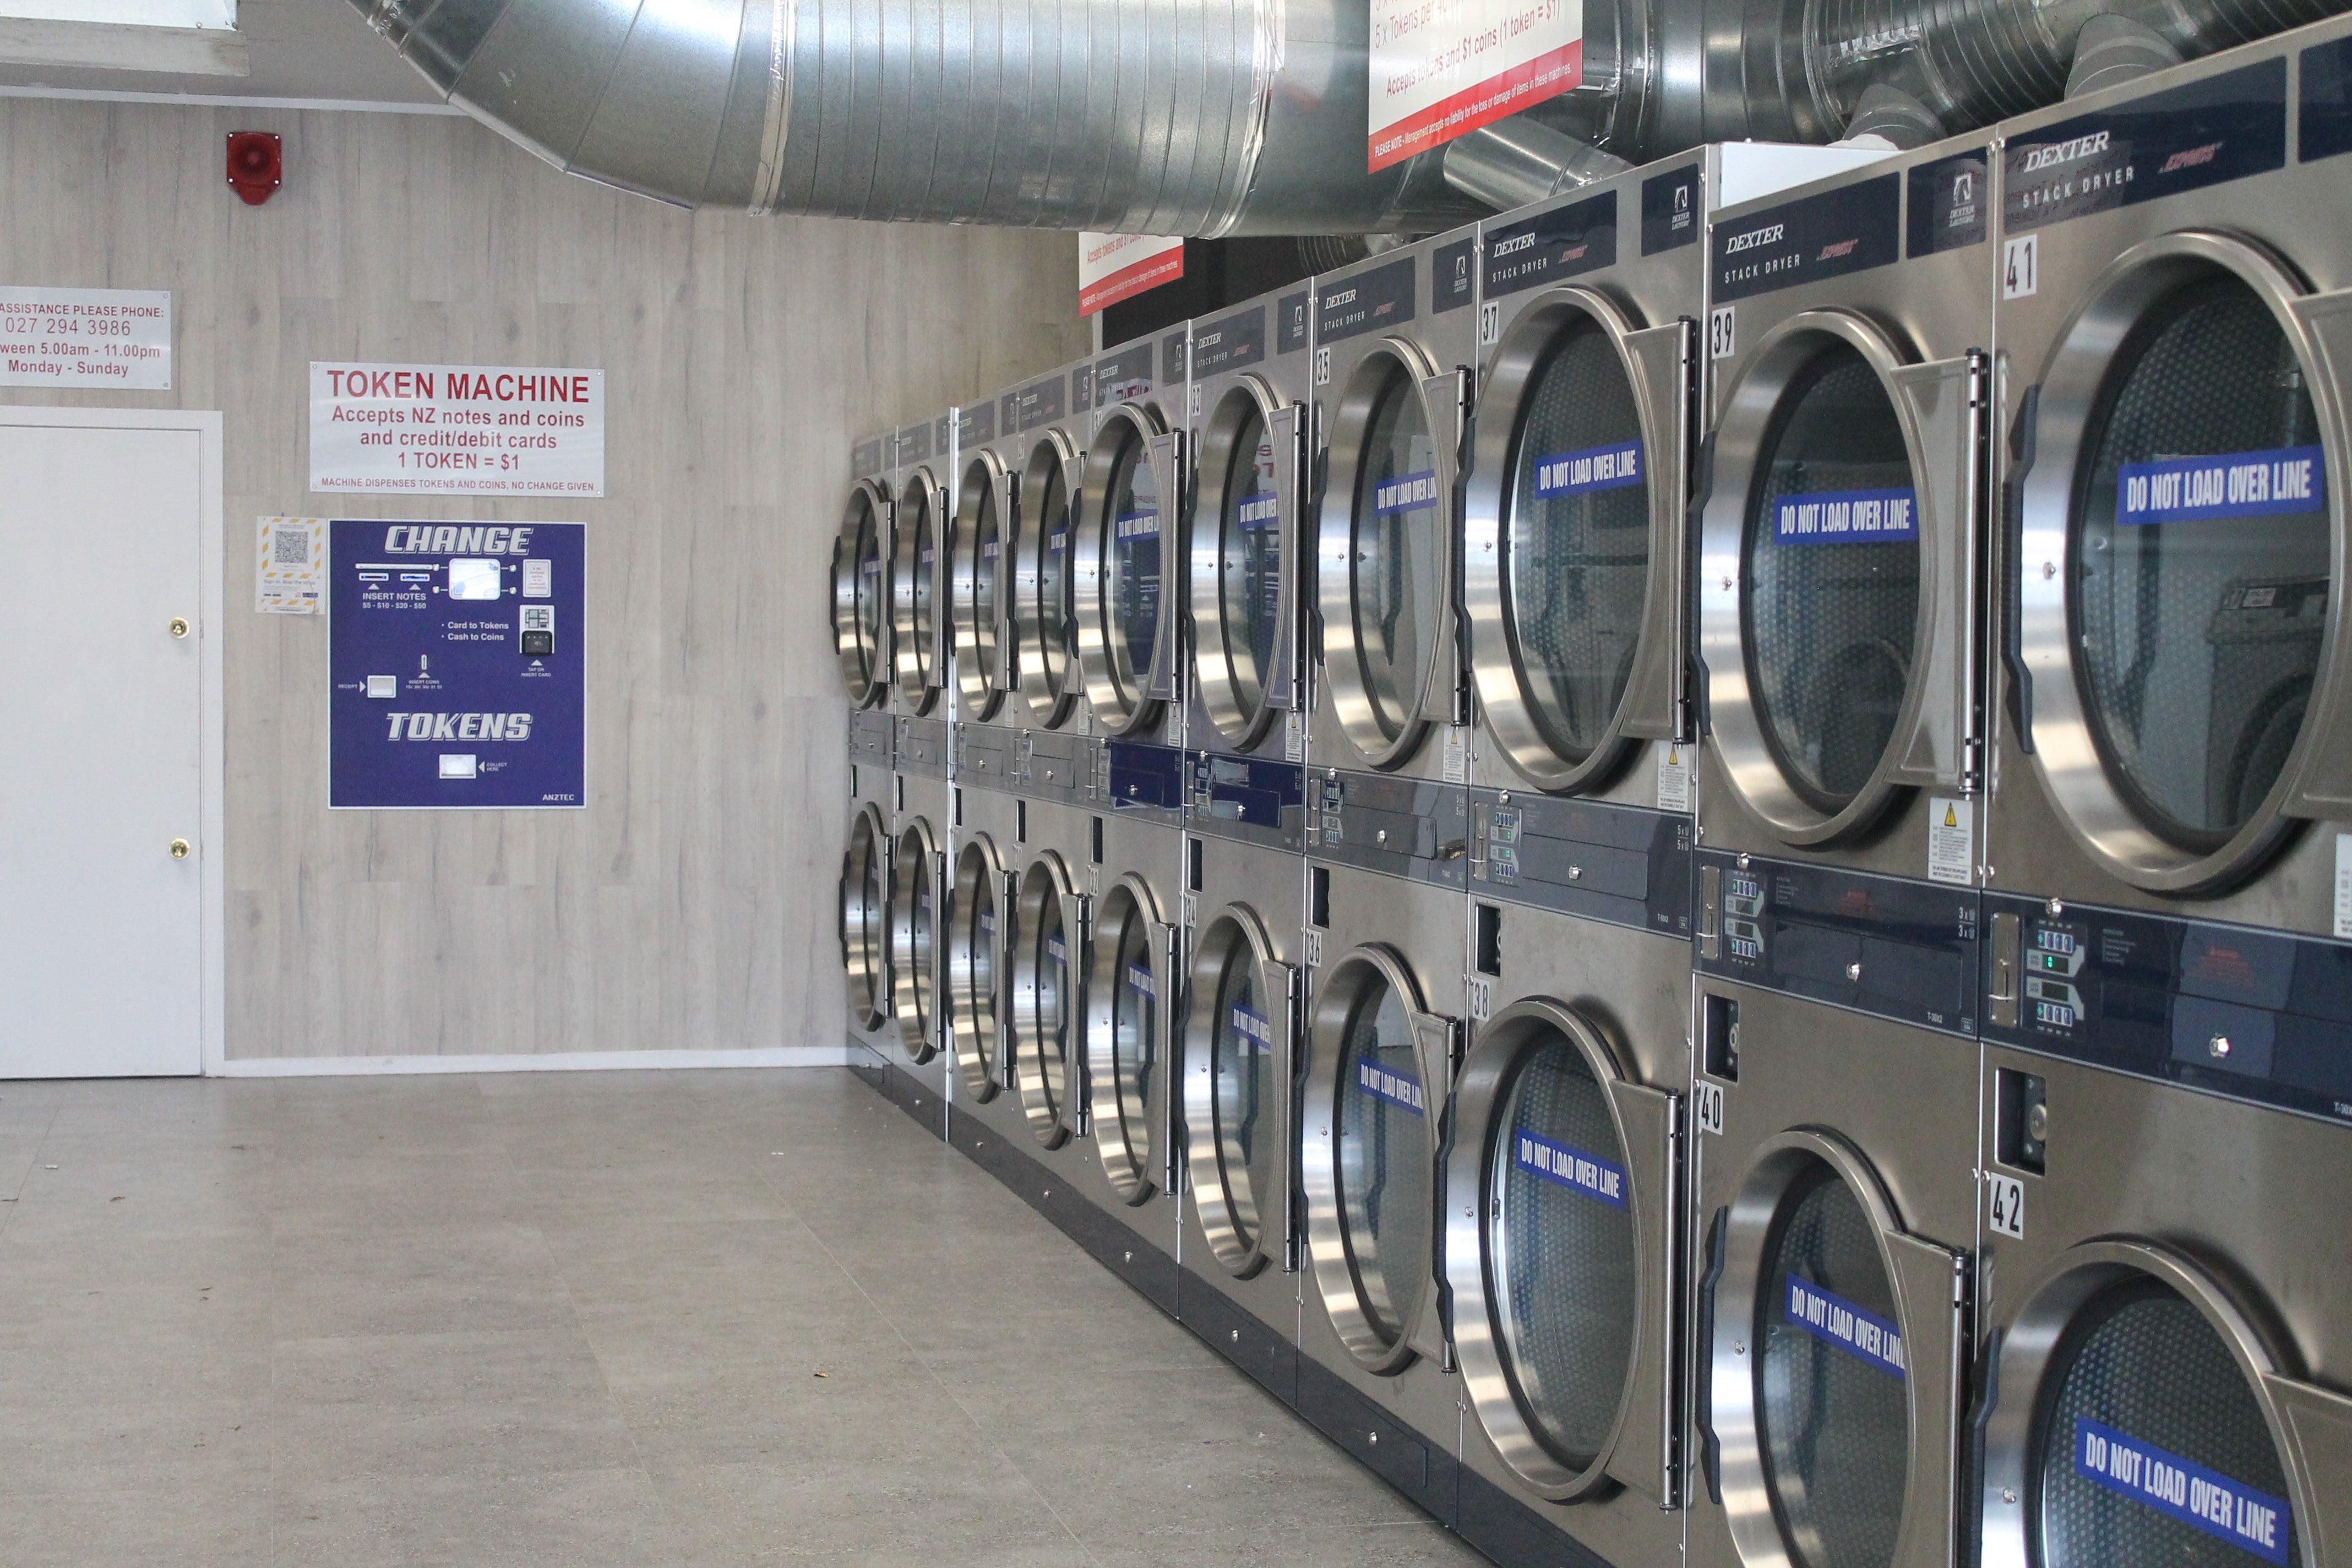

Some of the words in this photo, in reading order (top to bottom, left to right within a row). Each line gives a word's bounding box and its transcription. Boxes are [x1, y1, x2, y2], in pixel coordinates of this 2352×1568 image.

[1376, 24, 1380, 49] 5
[1382, 26, 1387, 45] x
[1390, 9, 1418, 41] Tokens
[1386, 70, 1416, 98] Accepts
[1418, 54, 1444, 87] tokens
[1445, 41, 1460, 70] and
[1463, 35, 1472, 63] $1
[1474, 28, 1497, 54] coins
[1500, 18, 1507, 48] (1
[1510, 8, 1536, 39] token
[1538, 5, 1543, 19] =
[1375, 137, 1391, 158] PLEASE
[1391, 134, 1402, 153] NOTE
[1405, 124, 1429, 146] Management
[1429, 119, 1444, 138] accepts
[1444, 116, 1450, 127] no
[1450, 108, 1464, 127] liability
[1479, 99, 1488, 113] loss
[1488, 98, 1493, 108] or
[1494, 89, 1511, 107] damage
[1511, 84, 1516, 99] of
[1517, 80, 1529, 96] items
[1529, 77, 1534, 90] in
[1535, 72, 1548, 88] these
[1548, 63, 1571, 83] machines.
[2024, 130, 2110, 174] DEXTER
[2022, 178, 2072, 209] STACK
[2083, 166, 2135, 194] DRYER
[1493, 232, 1537, 259] DEXTER
[1725, 224, 1784, 255] DEXTER
[1493, 265, 1517, 283] STACK
[1522, 258, 1548, 275] DRYER
[1724, 264, 1758, 284] STACK
[1765, 254, 1801, 274] DRYER
[2006, 240, 2033, 292] 41
[0, 303, 69, 315] ASSISTANCE
[73, 305, 117, 317] PLEASE
[121, 306, 164, 318] PHONE:
[1325, 289, 1357, 310] DEXTER
[6, 317, 37, 333] 027
[46, 318, 78, 335] 294
[88, 320, 131, 336] 3986
[1324, 316, 1343, 331] STACK
[1346, 311, 1365, 325] DRYER
[1483, 306, 1497, 342] 37
[1714, 311, 1732, 355] 39
[41, 341, 90, 357] 5.00am
[104, 343, 160, 358] 11.00pm
[8, 359, 63, 375] Monday
[77, 361, 129, 378] Sunday
[1317, 351, 1329, 382] 35
[326, 370, 434, 400] TOKEN
[447, 373, 589, 403] MACHINE
[331, 405, 405, 427] Accepts
[412, 407, 436, 424] NZ
[442, 409, 492, 425] notes
[498, 410, 530, 426] and
[537, 411, 585, 427] coins
[360, 429, 393, 445] and
[400, 430, 502, 448] credit/debit
[508, 433, 557, 449] cards
[398, 451, 406, 468] 1
[414, 453, 477, 469] TOKEN
[484, 458, 494, 466] =
[501, 453, 519, 471] $1
[1540, 464, 1551, 491] DO
[1553, 461, 1569, 488] NOT
[1570, 457, 1592, 486] LOAD
[1593, 453, 1615, 482] OVER
[1616, 449, 1636, 478] LINE
[322, 477, 362, 487] MACHINE
[366, 478, 416, 488] DISPENSES
[419, 479, 455, 489] TOKENS
[458, 480, 476, 489] AND
[478, 481, 509, 491] COINS,
[511, 481, 524, 490] NO
[527, 481, 565, 491] CHANGE
[567, 482, 594, 492] GIVEN
[1378, 487, 1385, 510] DO
[1386, 485, 1397, 508] NOT
[1398, 482, 1412, 505] LOAD
[1412, 478, 1427, 502] OVER
[1428, 477, 1437, 499] LIN
[2127, 476, 2147, 513] DO
[2150, 472, 2181, 510] NOT
[2184, 467, 2224, 508] LOAD
[2228, 463, 2269, 504] OVER
[2273, 459, 2311, 500] LINE
[1781, 505, 1796, 535] DO
[1798, 503, 1820, 533] NOT
[1821, 502, 1850, 533] LOAD
[1852, 500, 1881, 531] OVER
[1883, 498, 1910, 530] LINE
[385, 525, 534, 556] CHANGE
[447, 622, 467, 630] Card
[479, 622, 509, 630] Tokens
[447, 633, 469, 641] Cash
[470, 633, 479, 641] to
[480, 633, 505, 641] Coins
[386, 713, 533, 742] TOKENS
[1310, 934, 1320, 963] 36
[1474, 982, 1488, 1017] 38
[1361, 1064, 1369, 1086] DO
[1369, 1068, 1380, 1091] NOT
[1381, 1072, 1395, 1098] LOAD
[1396, 1079, 1411, 1104] OVER
[1702, 1086, 1720, 1129] 40
[1521, 1137, 1533, 1164] DO
[1534, 1142, 1551, 1171] NOT
[1552, 1149, 1574, 1180] LOAD
[1576, 1158, 1598, 1190] OVER
[1599, 1167, 1620, 1199] LINE
[1993, 1180, 2019, 1232] 42
[1792, 1285, 1805, 1317] DO
[1806, 1293, 1827, 1328] NOT
[1827, 1303, 1853, 1342] LOAD
[1855, 1317, 1881, 1357] OVER
[2086, 1431, 2107, 1472] DO
[2110, 1442, 2142, 1488] NOT
[2144, 1457, 2186, 1507] LOAD
[2190, 1476, 2233, 1529] OVER
[2236, 1496, 2277, 1548] LINE
